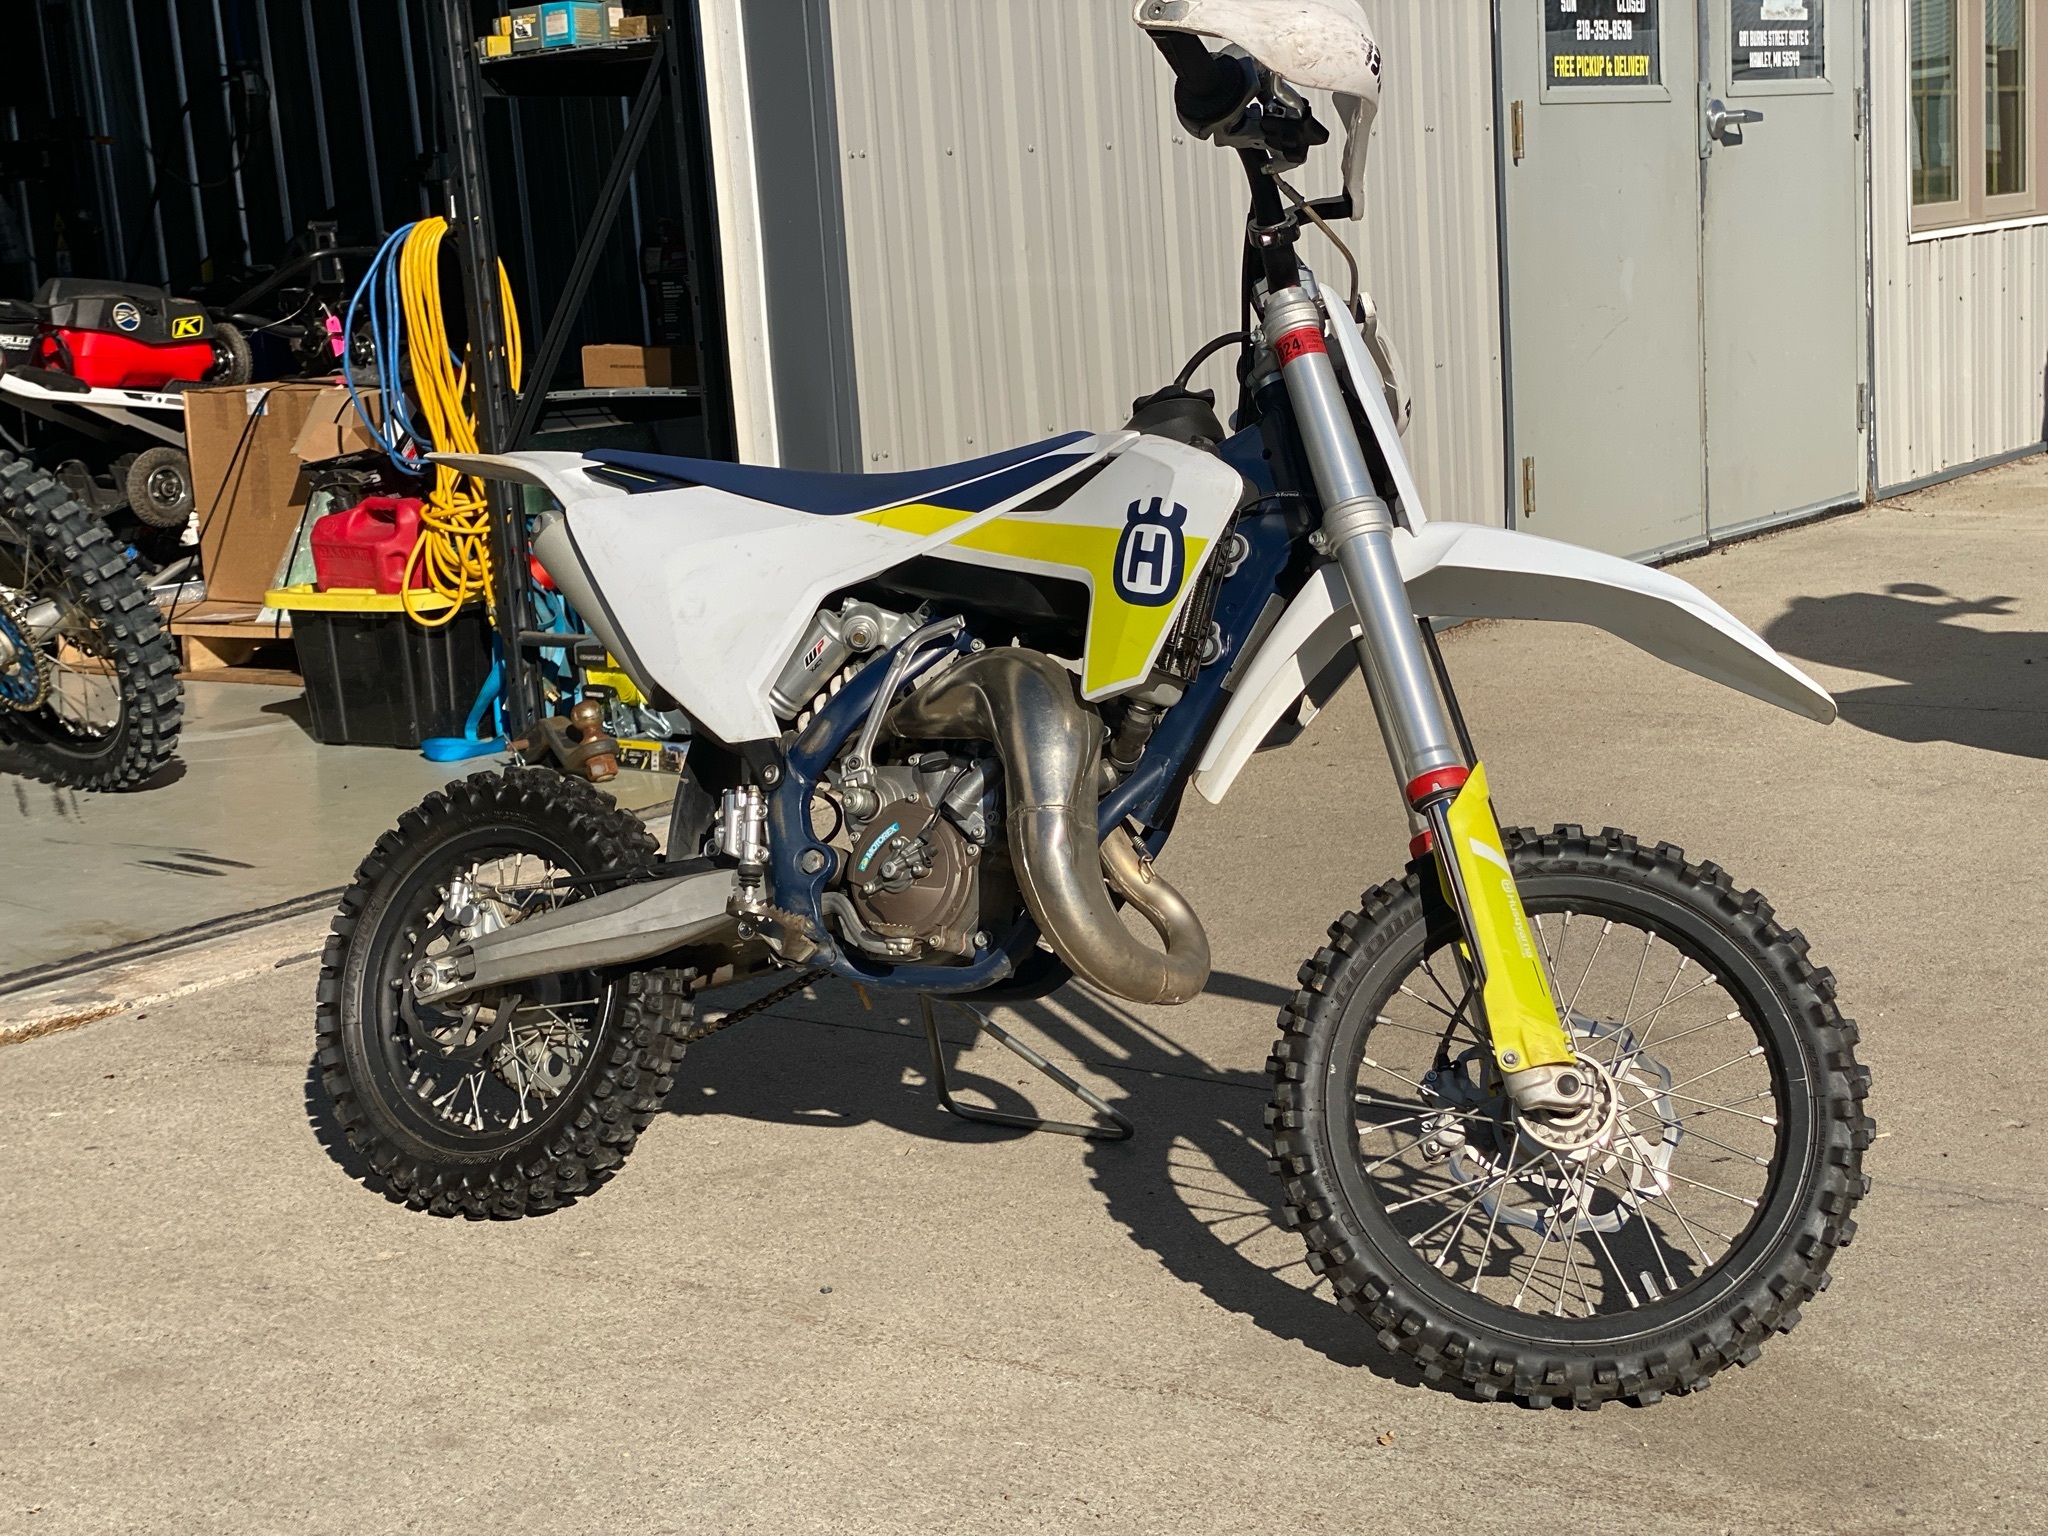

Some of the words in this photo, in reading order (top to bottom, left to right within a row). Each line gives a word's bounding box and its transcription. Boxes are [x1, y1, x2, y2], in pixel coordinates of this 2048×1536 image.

[1617, 0, 1645, 13] CLOSED
[1768, 30, 1788, 46] STREET
[1554, 55, 1575, 77] FREE
[1576, 55, 1604, 77] PICKUP
[1606, 55, 1613, 76] &
[1614, 55, 1649, 76] DELIVERY
[177, 317, 200, 335] K
[0, 334, 32, 345] SLED
[1127, 531, 1166, 586] H
[1507, 894, 1533, 958] Husqvarna
